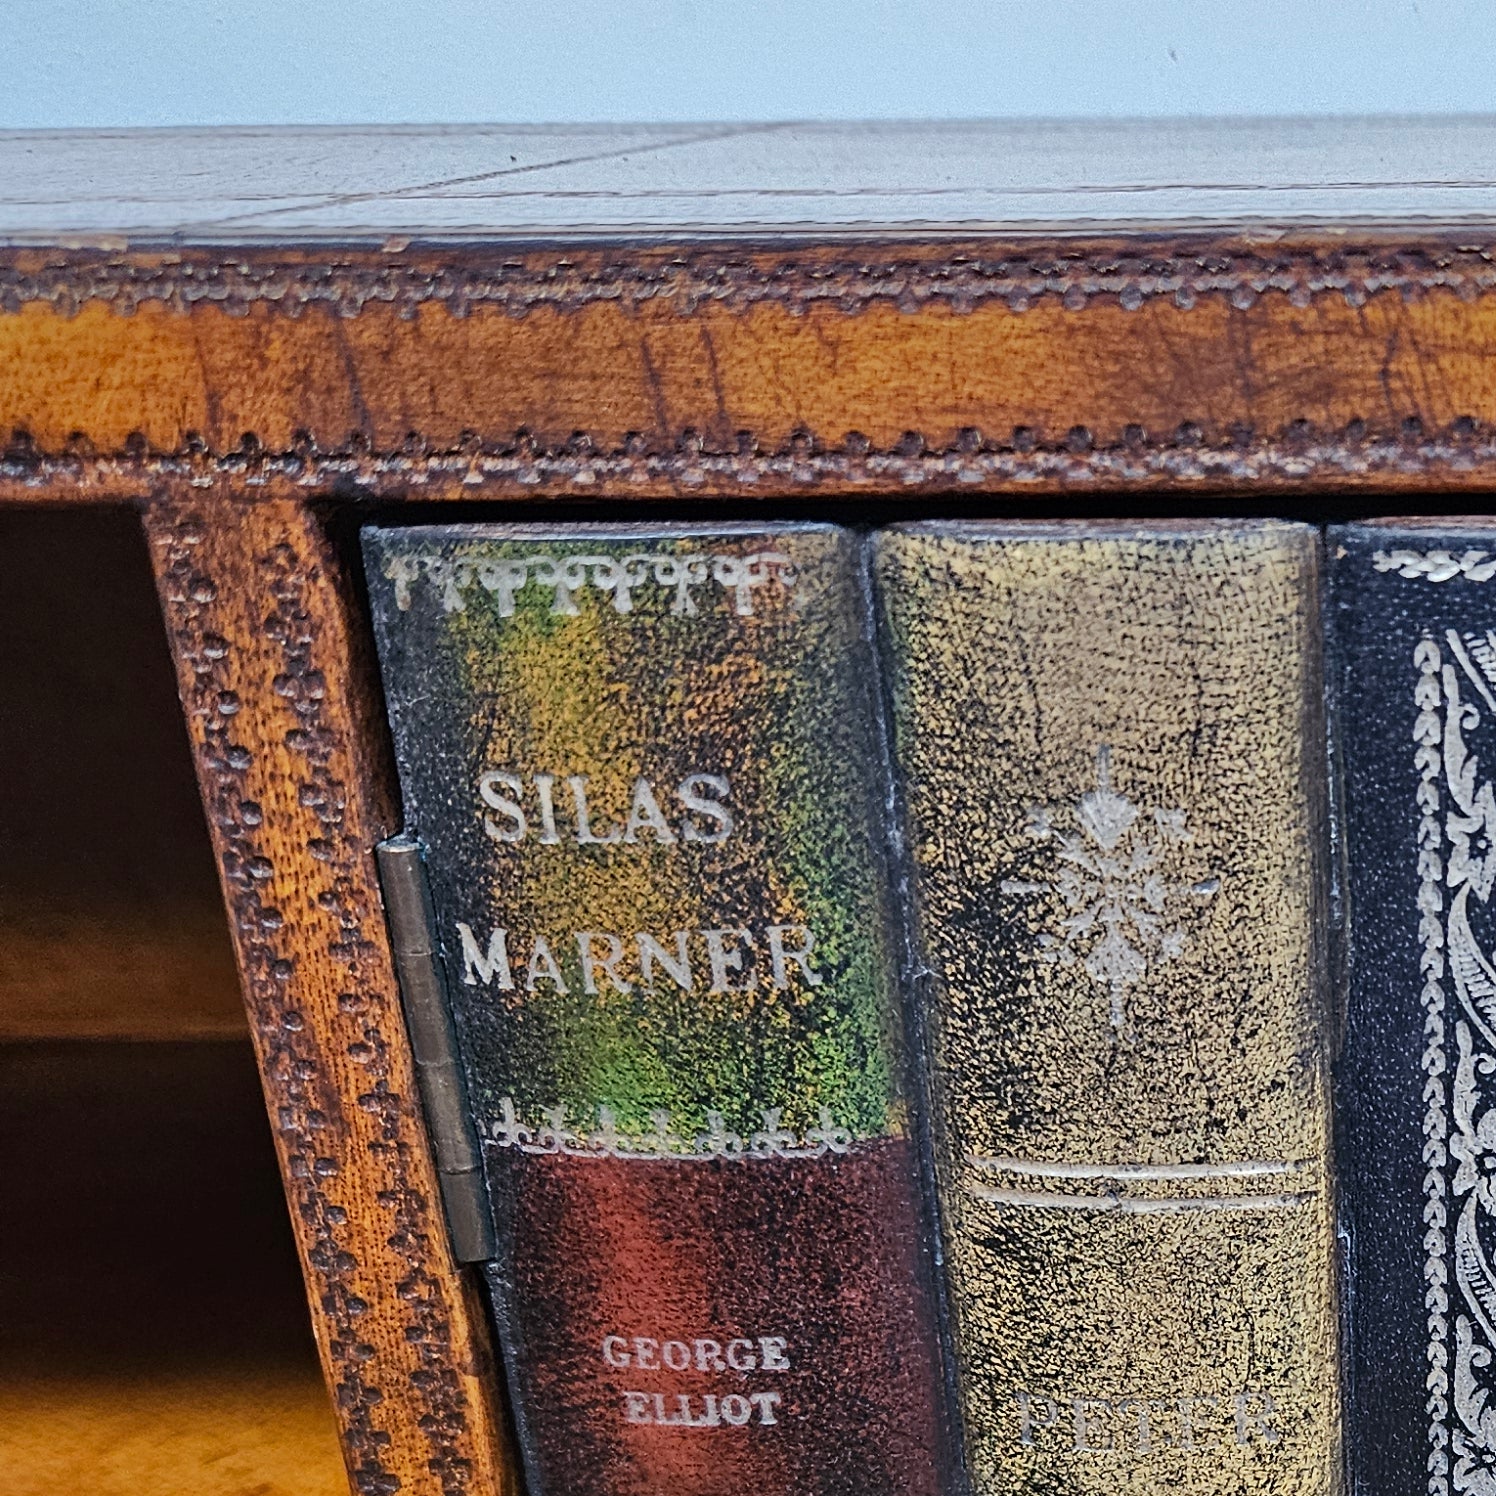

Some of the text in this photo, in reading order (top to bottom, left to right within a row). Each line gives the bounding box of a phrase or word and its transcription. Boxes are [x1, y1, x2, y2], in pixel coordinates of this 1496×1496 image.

[479, 770, 734, 845] SILAS
[455, 922, 824, 995] MARNER
[602, 1335, 791, 1372] GEORGE
[623, 1391, 781, 1426] ELLIOT
[1014, 1389, 1280, 1451] PETER
